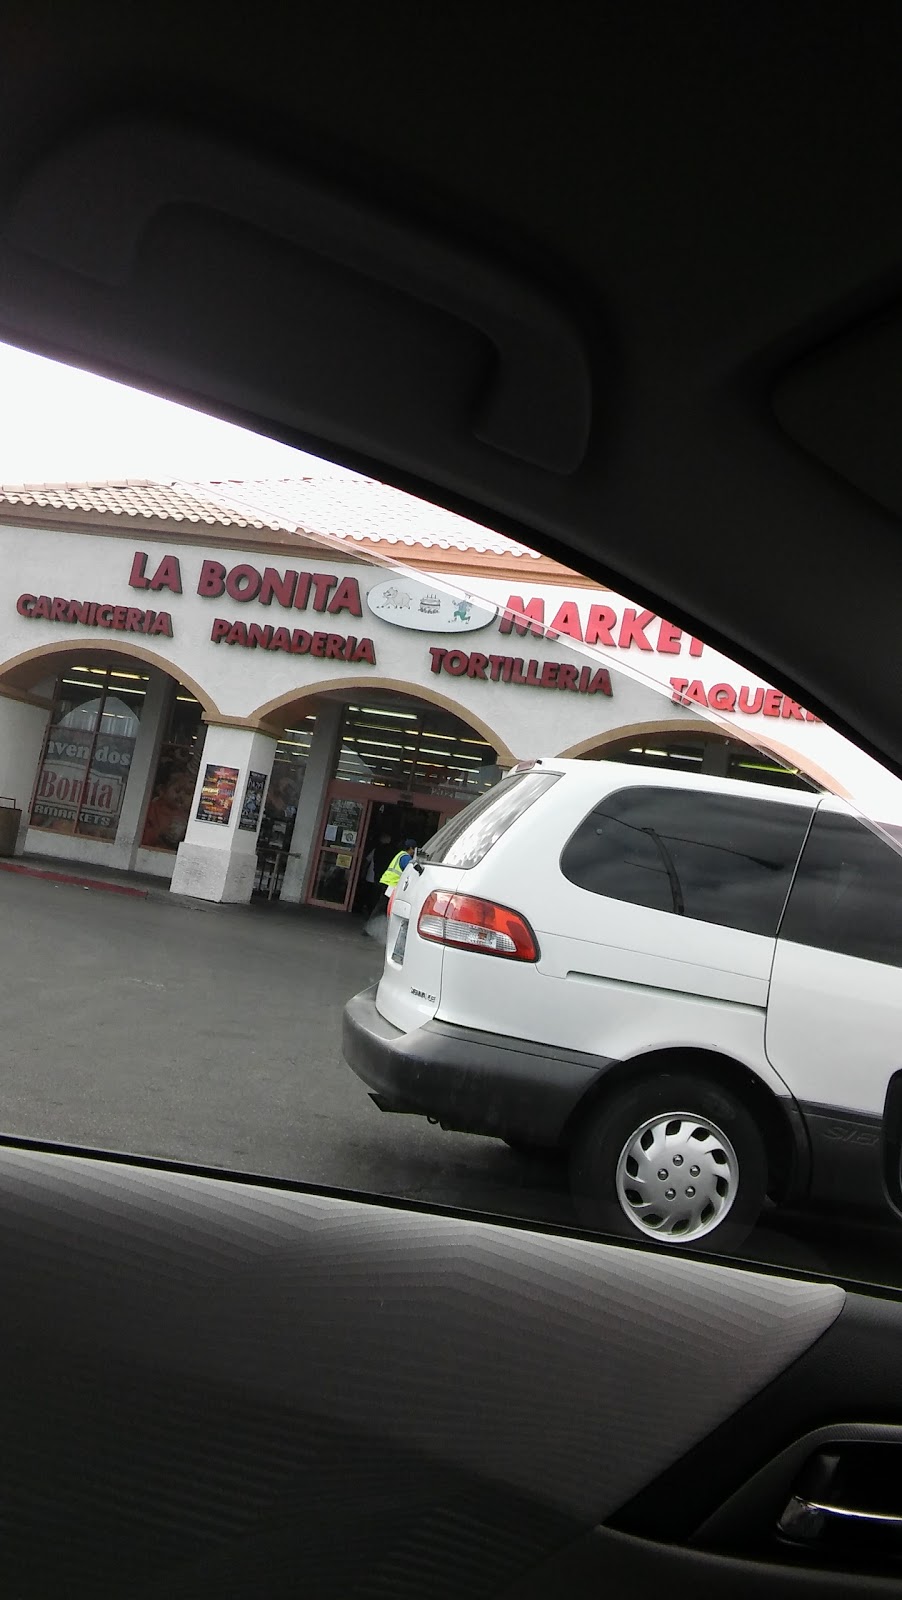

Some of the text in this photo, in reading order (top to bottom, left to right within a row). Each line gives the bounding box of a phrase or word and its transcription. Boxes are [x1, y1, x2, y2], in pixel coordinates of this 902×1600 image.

[128, 551, 183, 595] LA
[197, 559, 364, 618] BONITA
[16, 593, 174, 638] CARNICERIA
[210, 618, 377, 666] PANADERIA
[428, 647, 614, 697] TORTILLERIA
[669, 677, 823, 723] TAQUER
